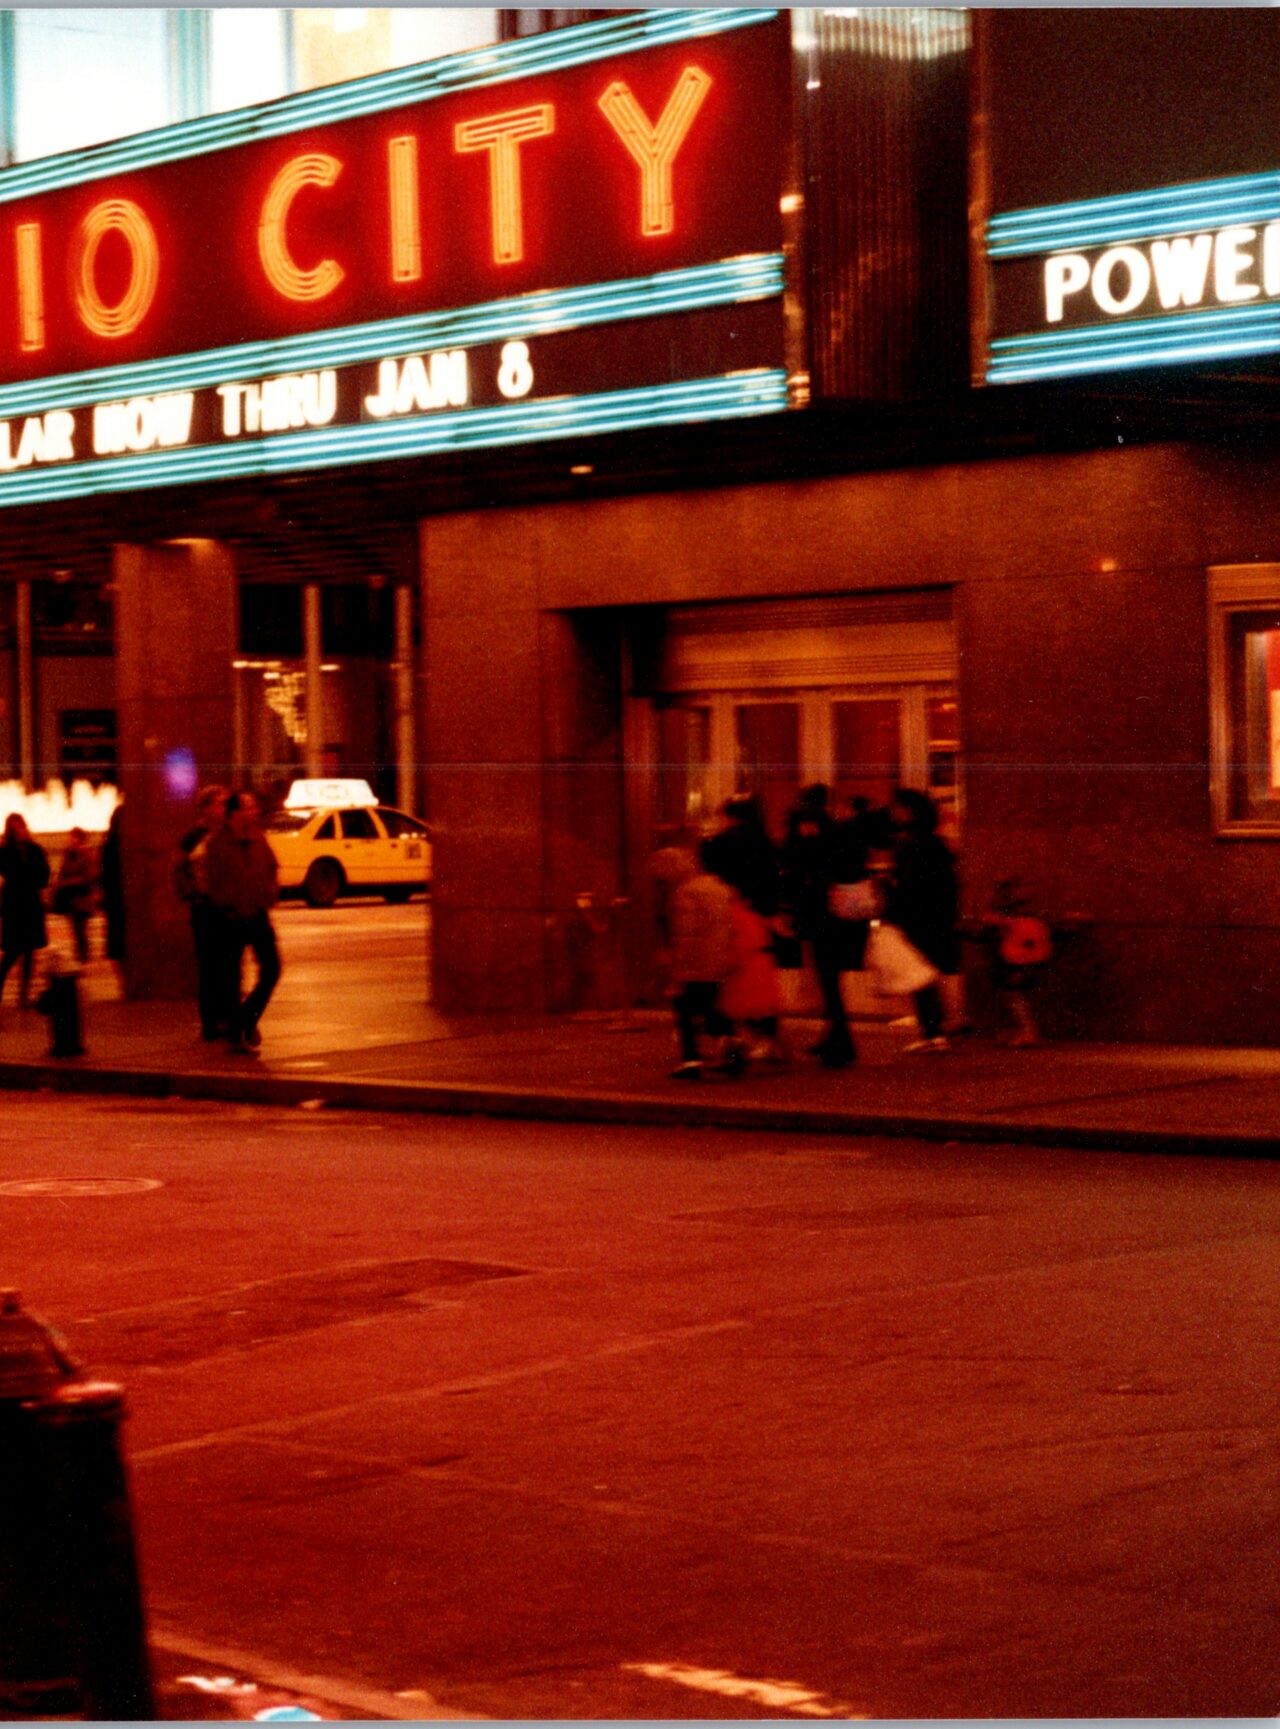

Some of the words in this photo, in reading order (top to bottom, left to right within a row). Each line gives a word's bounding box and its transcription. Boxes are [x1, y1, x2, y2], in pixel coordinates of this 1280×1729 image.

[257, 66, 712, 301] CITY
[93, 392, 195, 455] NOW
[217, 370, 337, 437] THRU
[365, 350, 468, 419] JAN
[497, 340, 534, 399] 8
